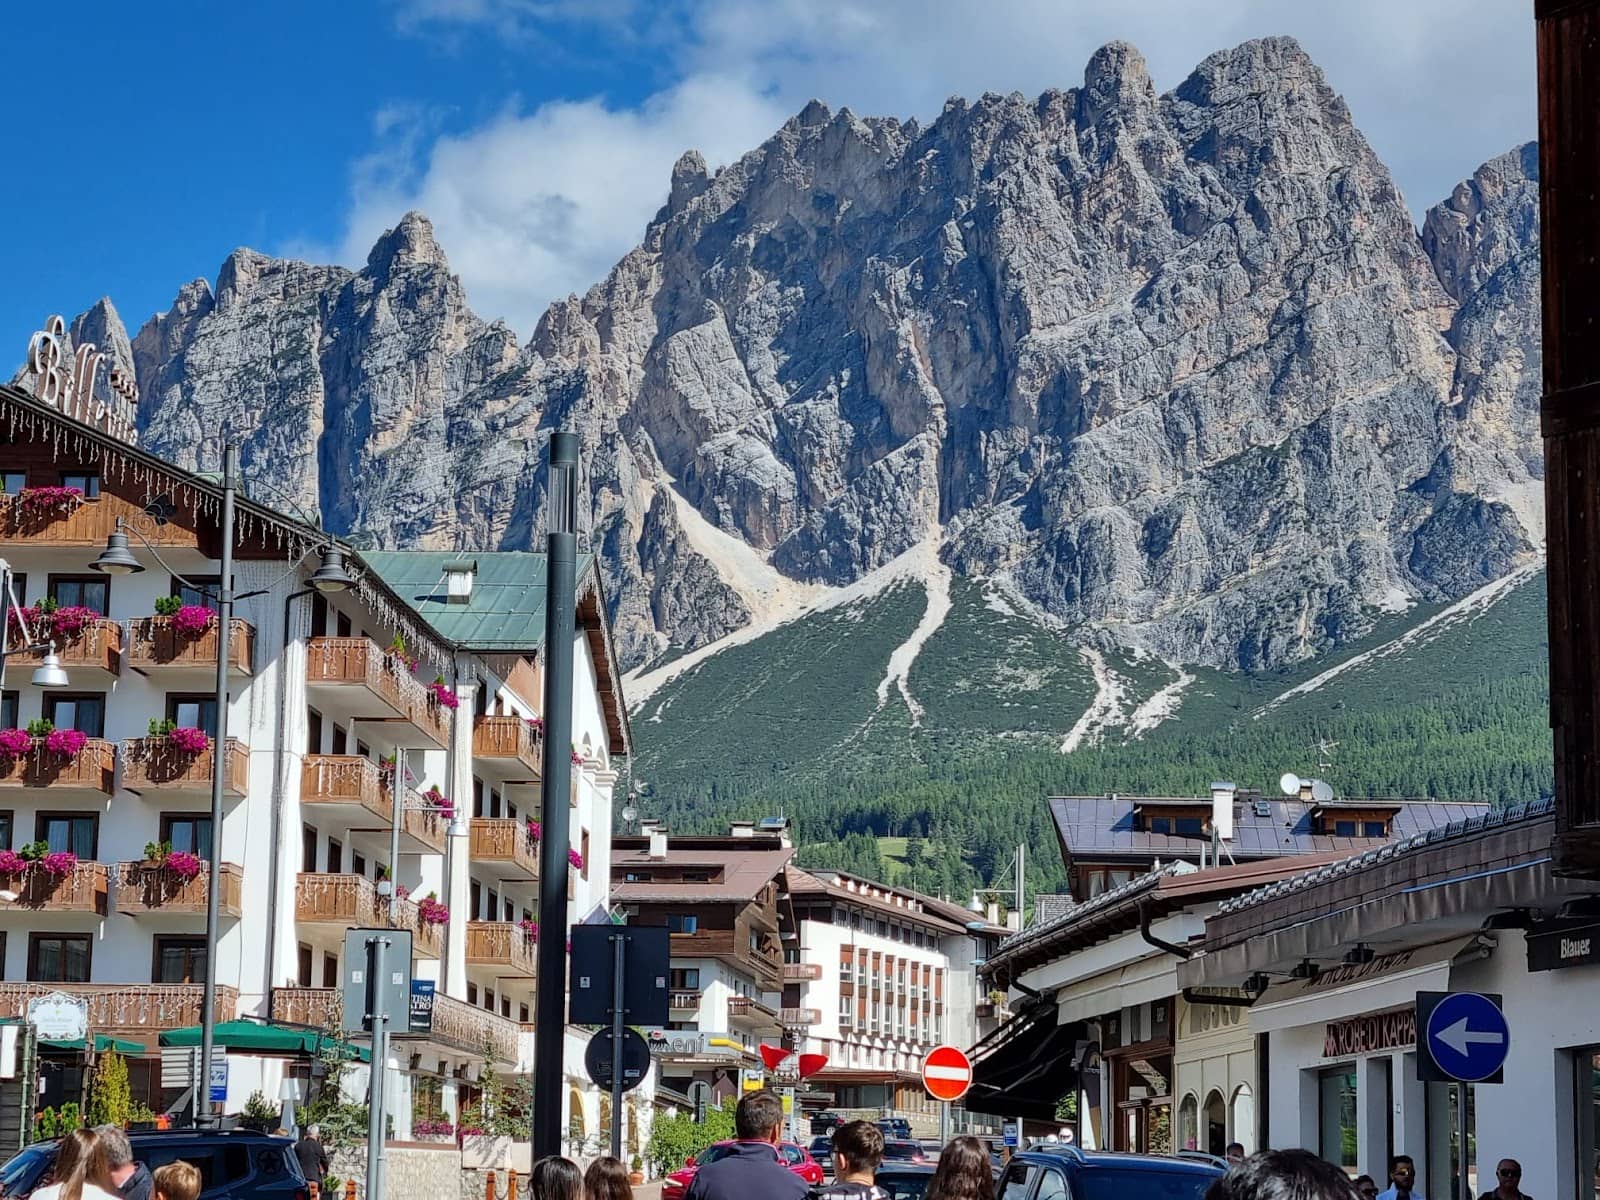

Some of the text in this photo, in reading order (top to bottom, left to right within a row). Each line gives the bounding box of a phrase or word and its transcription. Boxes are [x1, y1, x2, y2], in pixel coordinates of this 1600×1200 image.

[1560, 937, 1591, 959] Blauer
[411, 994, 431, 1002] TINA
[672, 1033, 705, 1054] eni
[1338, 1019, 1366, 1054] ROBE
[1382, 1012, 1417, 1048] KAPPA
